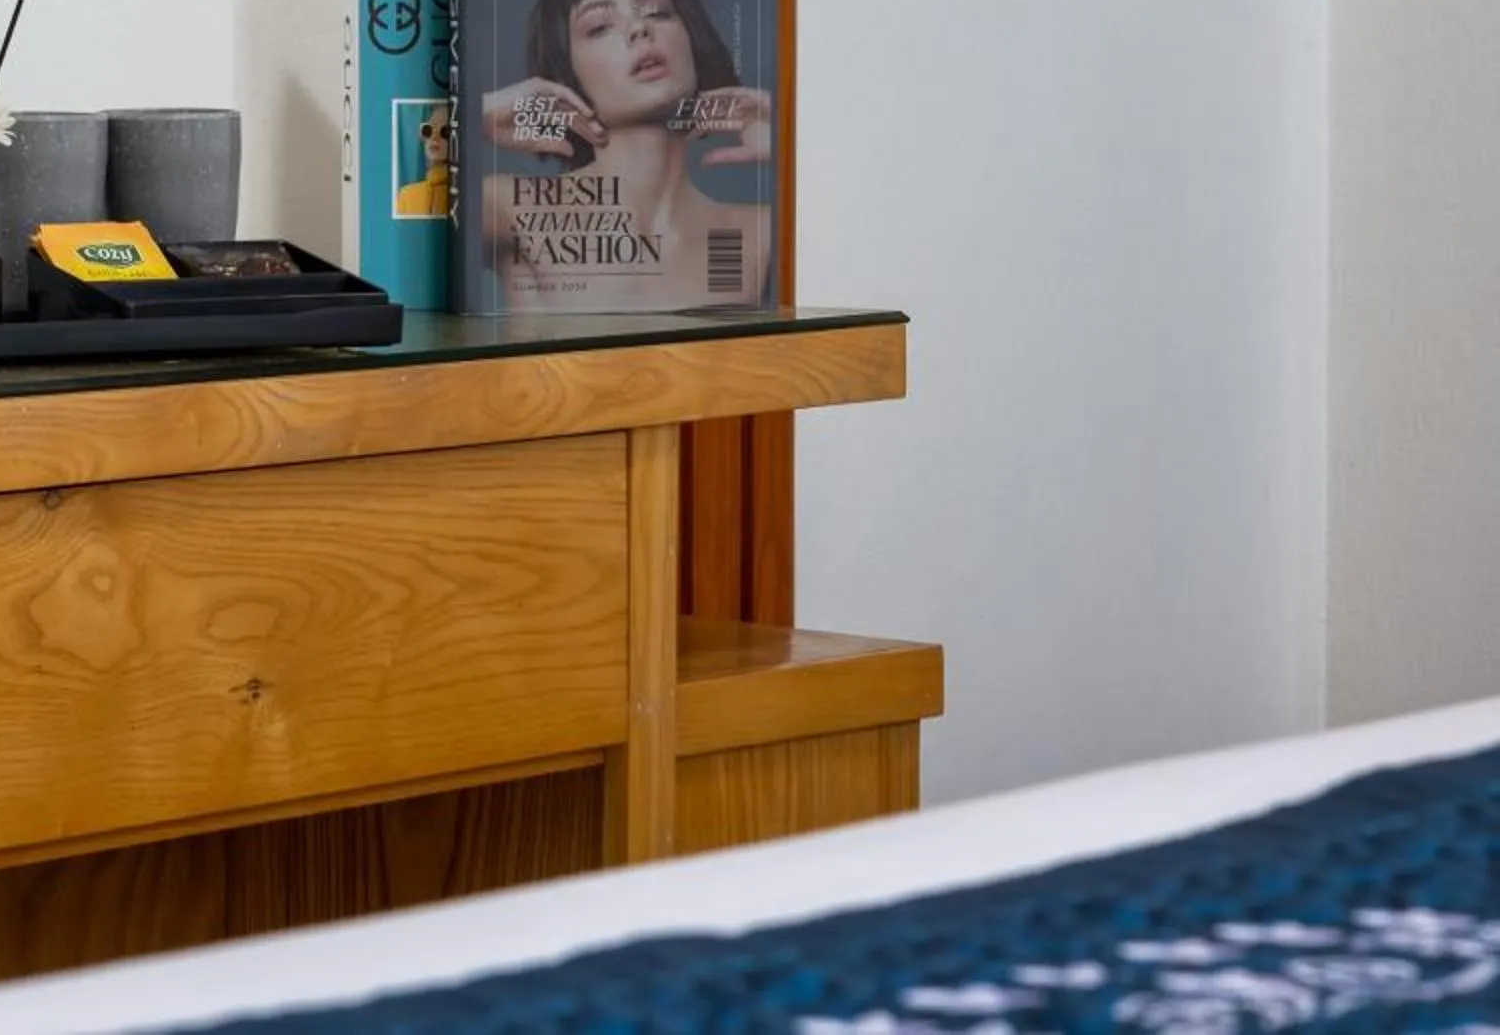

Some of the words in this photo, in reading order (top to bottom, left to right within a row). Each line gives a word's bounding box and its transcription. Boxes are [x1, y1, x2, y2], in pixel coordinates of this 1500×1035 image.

[513, 96, 557, 112] BEST
[514, 111, 578, 126] OUTFIT
[514, 126, 566, 141] IDEAS
[513, 176, 620, 206] FRESH
[514, 212, 632, 233] SUMMER
[513, 234, 662, 264] FASHION
